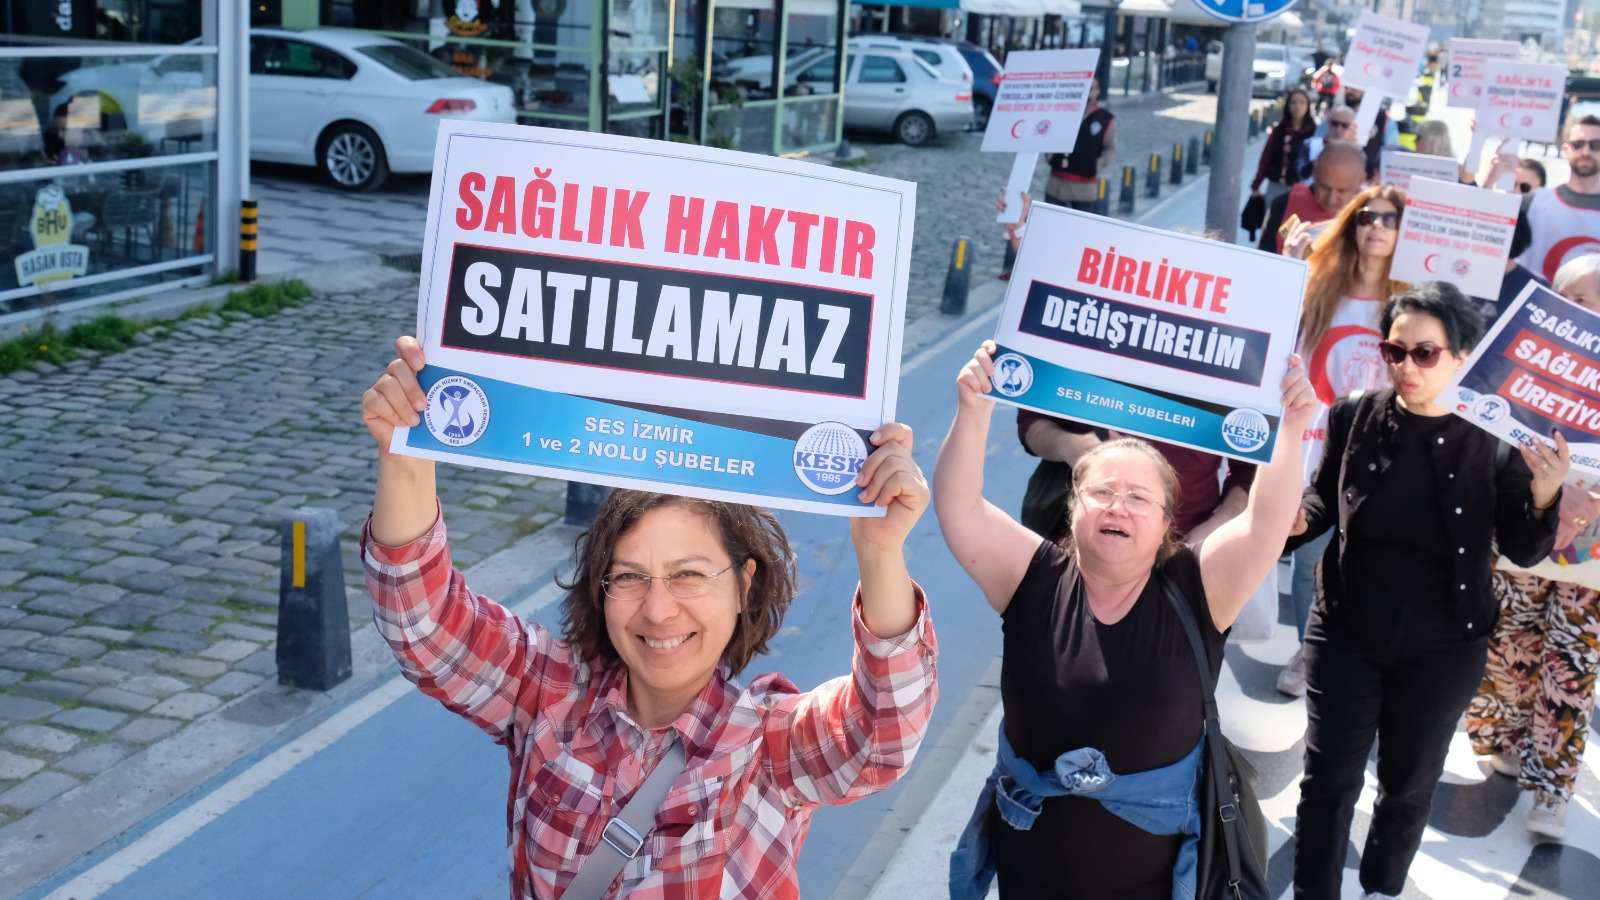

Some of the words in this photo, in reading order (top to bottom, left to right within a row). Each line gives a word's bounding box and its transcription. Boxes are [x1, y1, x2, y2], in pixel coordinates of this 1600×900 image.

[455, 167, 650, 249] SAĞLIK
[664, 195, 876, 280] HAKTIR
[21, 253, 57, 277] HASAN
[60, 251, 83, 268] USTA
[1077, 246, 1232, 314] BİRLİKTE
[460, 261, 850, 379] SATILAMAZ
[1041, 293, 1246, 370] DEĞİŞTİRELİM
[1515, 338, 1600, 393] SAĞLIK
[1056, 386, 1082, 401] SES
[1086, 391, 1125, 411] İZMİR
[1128, 404, 1196, 428] ŞUBELERİ
[585, 416, 625, 436] SES
[633, 418, 694, 445] İZMİR
[1223, 423, 1268, 443] KESK
[522, 431, 531, 447] 1
[539, 437, 562, 451] ve
[569, 438, 581, 454] 2
[588, 440, 647, 462] NOLU
[654, 449, 755, 477] ŞUBELER
[795, 451, 865, 473] KESK
[815, 472, 841, 483] 1995
